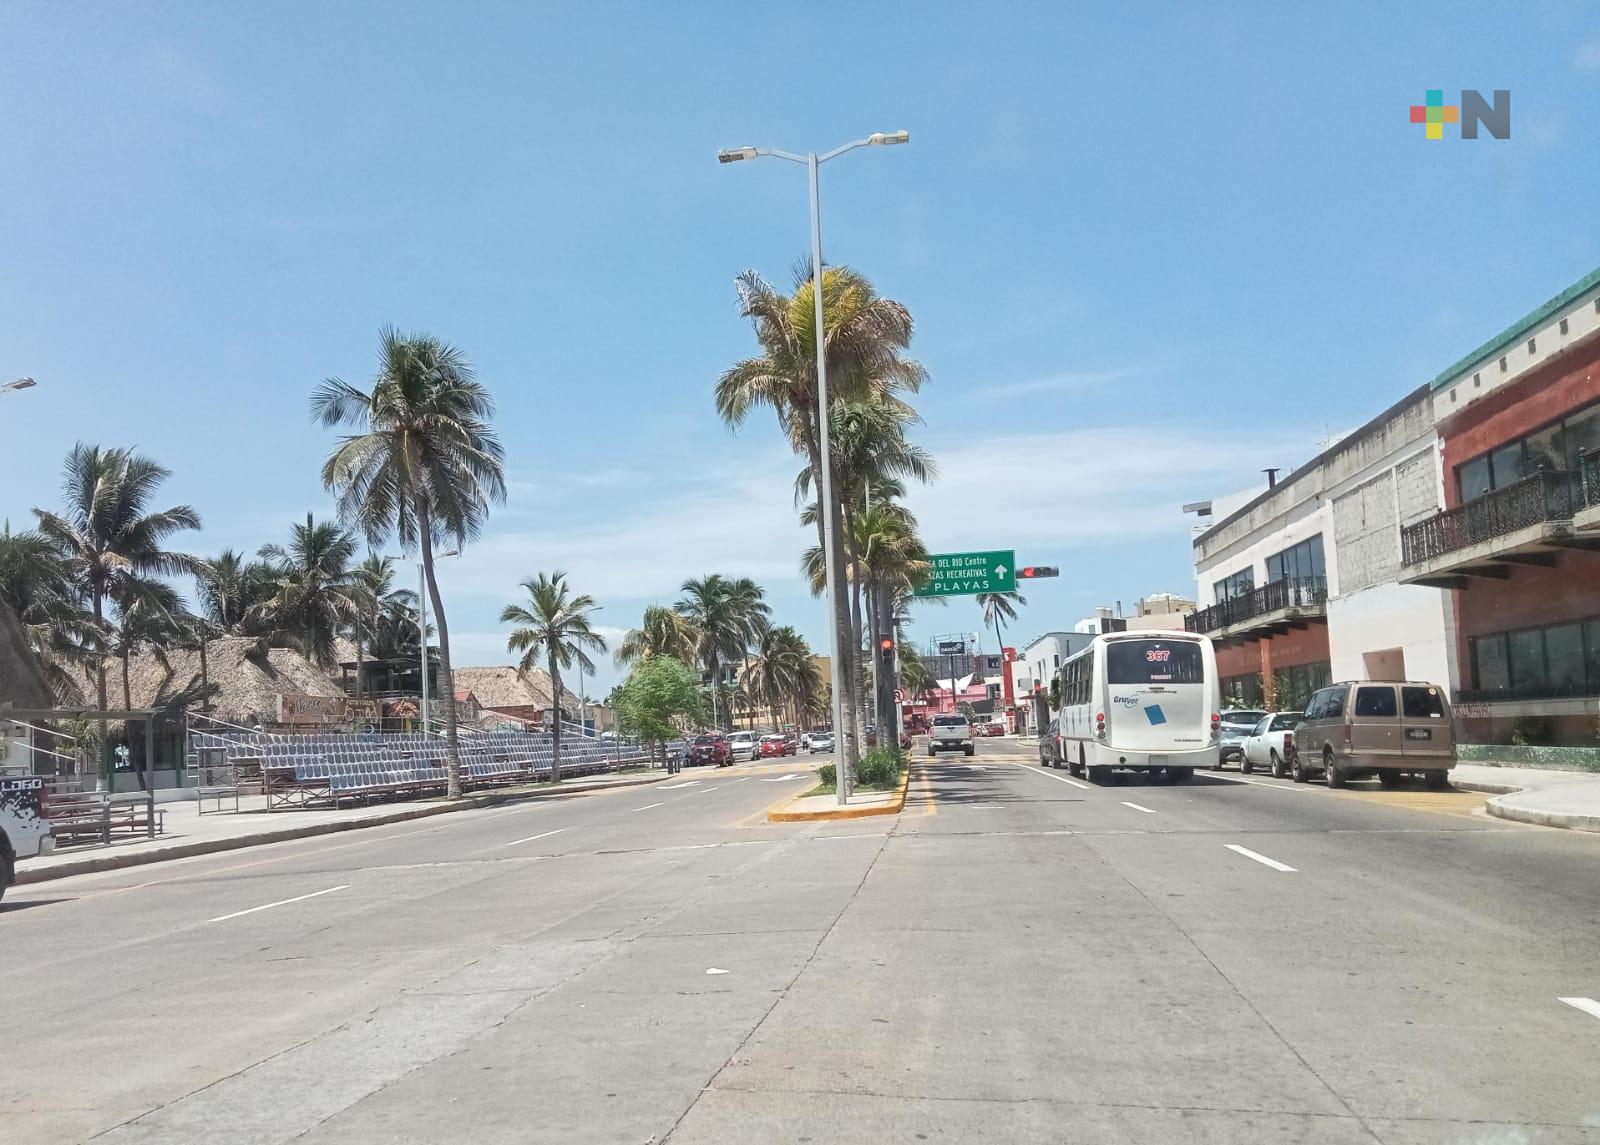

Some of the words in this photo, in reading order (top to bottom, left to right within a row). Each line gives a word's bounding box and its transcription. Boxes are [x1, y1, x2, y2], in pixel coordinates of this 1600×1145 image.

[938, 560, 950, 568] DEL
[964, 557, 986, 566] Centro
[946, 568, 986, 578] RECREATIVAS
[934, 580, 989, 591] PLAYAS
[1146, 650, 1170, 662] 367
